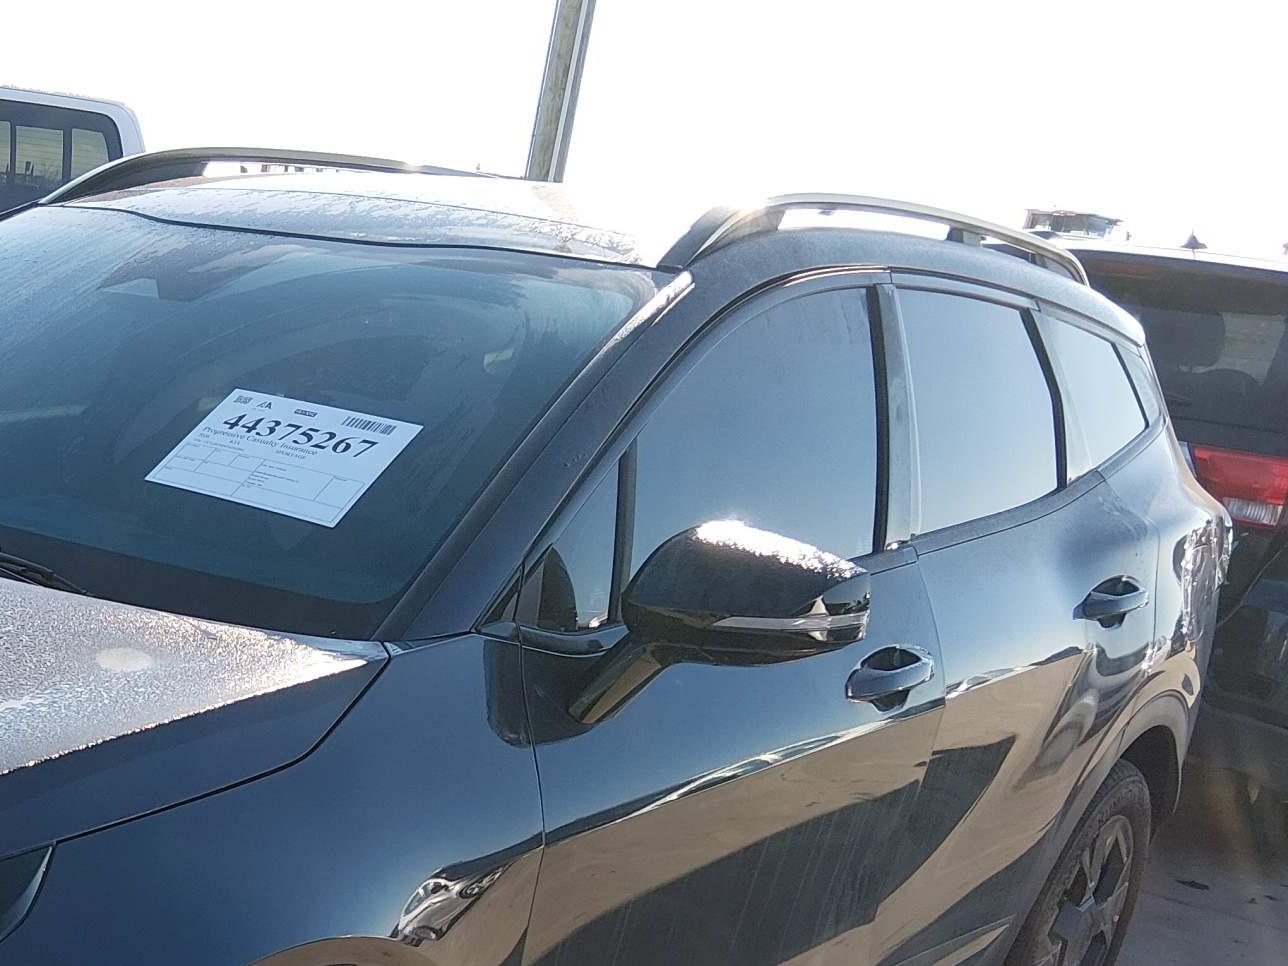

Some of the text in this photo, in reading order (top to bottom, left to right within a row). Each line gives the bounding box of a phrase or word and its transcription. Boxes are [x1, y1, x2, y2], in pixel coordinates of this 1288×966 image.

[202, 425, 246, 439] Progressive
[246, 435, 279, 448] Casualty
[279, 442, 318, 456] Insurance
[222, 413, 380, 458] 44375267
